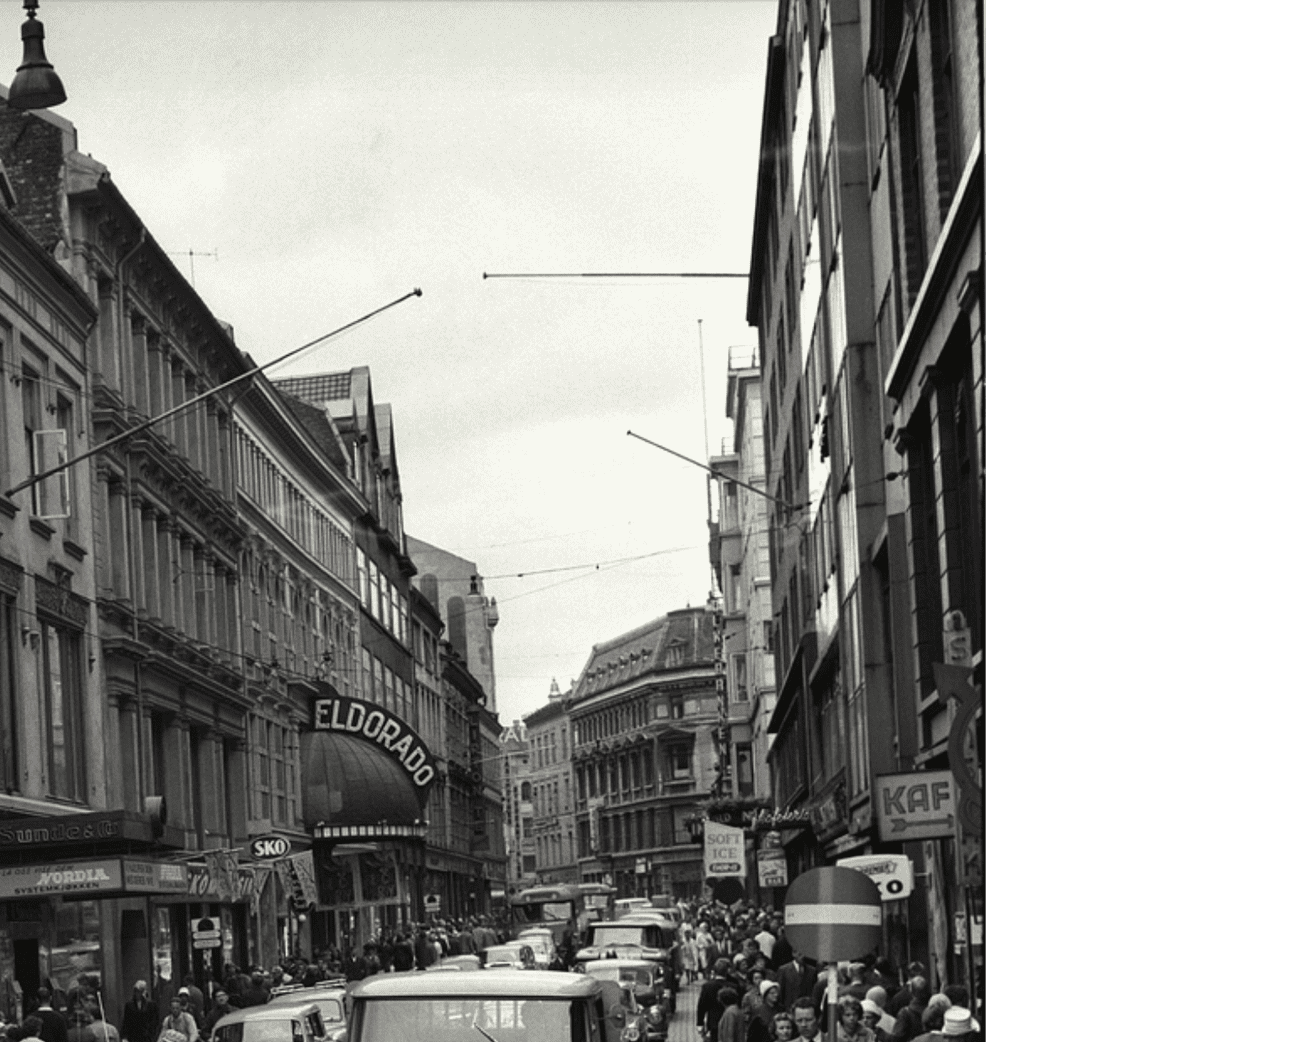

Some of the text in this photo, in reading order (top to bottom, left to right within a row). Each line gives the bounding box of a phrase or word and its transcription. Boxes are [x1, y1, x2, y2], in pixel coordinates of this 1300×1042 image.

[315, 699, 435, 786] ELDORADO
[883, 781, 950, 816] KAF
[254, 839, 285, 857] SKO
[707, 833, 741, 845] SOFT
[713, 848, 738, 859] ICE
[37, 868, 110, 886] NORDIA
[14, 882, 99, 895] SYSTEMKJØKKEN
